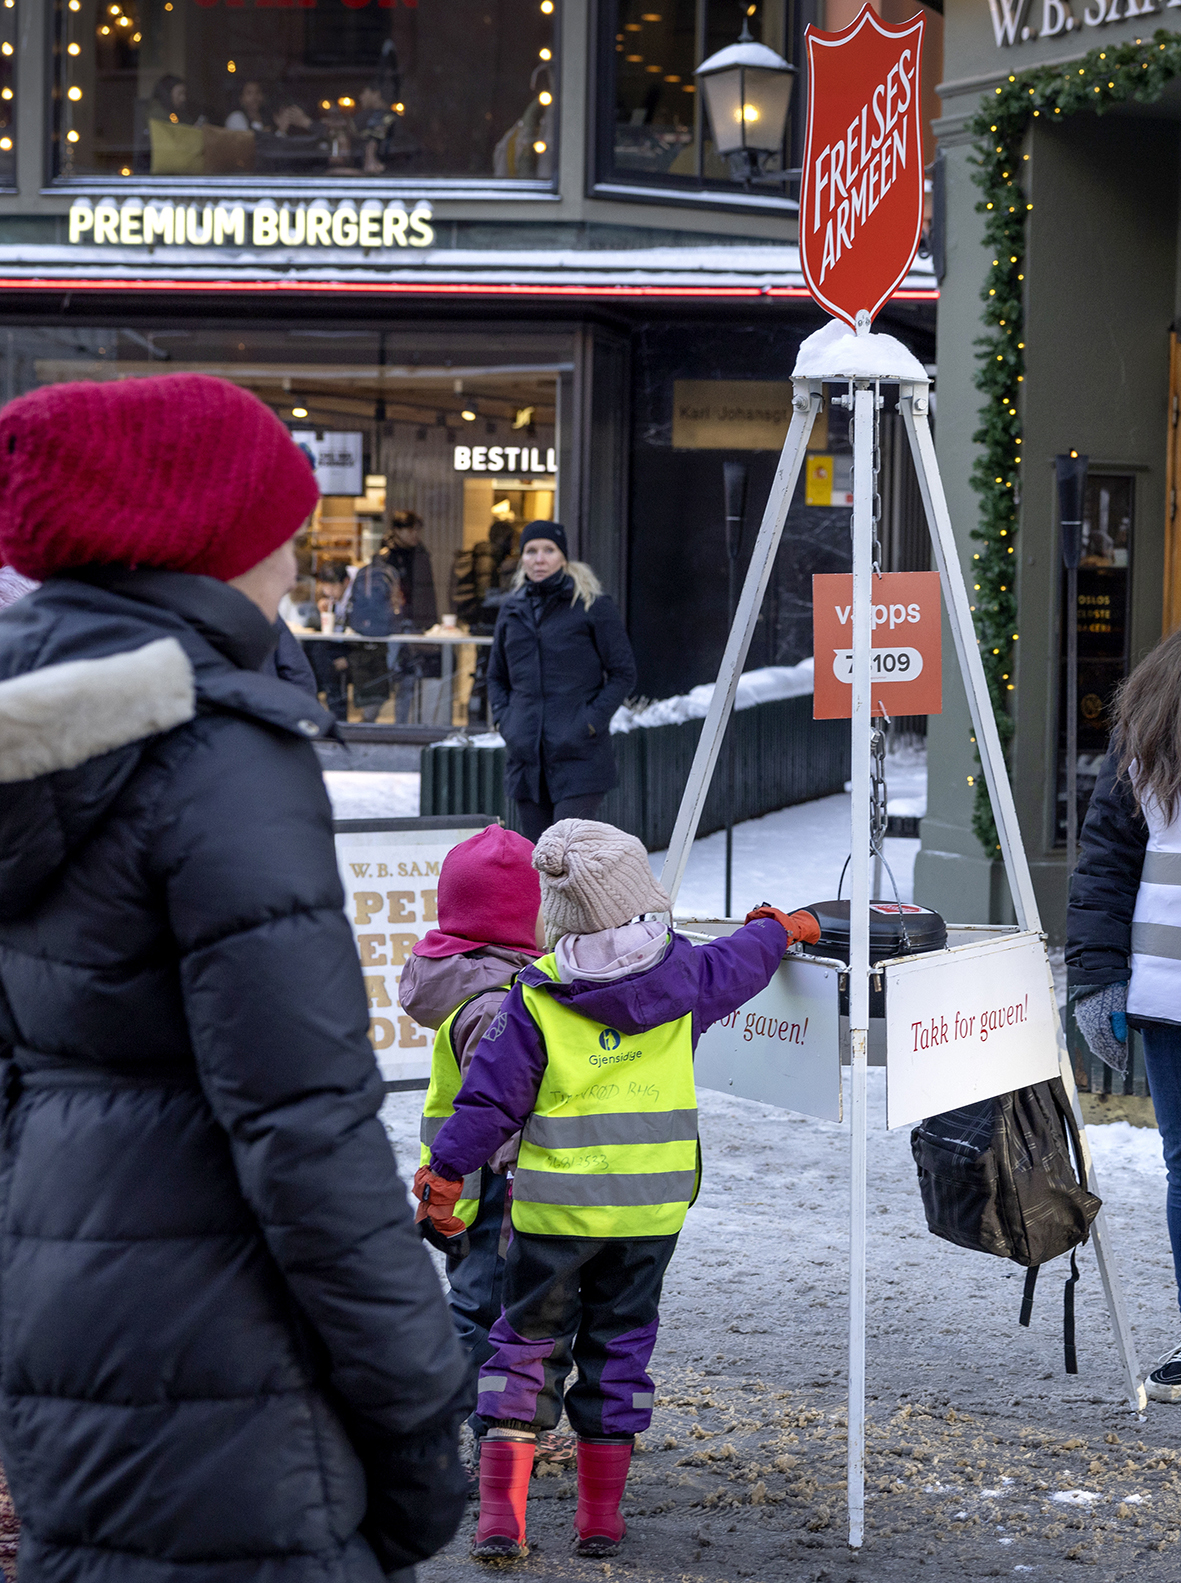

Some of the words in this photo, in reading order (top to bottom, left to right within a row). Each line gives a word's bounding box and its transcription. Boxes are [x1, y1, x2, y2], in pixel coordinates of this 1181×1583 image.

[818, 114, 909, 287] ARMEEN
[68, 205, 246, 246] PREMIUM
[252, 206, 435, 248] BURGERS
[834, 603, 921, 630] vpps
[845, 653, 911, 674] 7109
[349, 863, 373, 878] W.
[377, 863, 393, 878] B.
[743, 1012, 809, 1046] gaven!
[910, 1015, 949, 1052] Takk
[954, 1010, 976, 1041] for
[979, 993, 1029, 1042] gaven!
